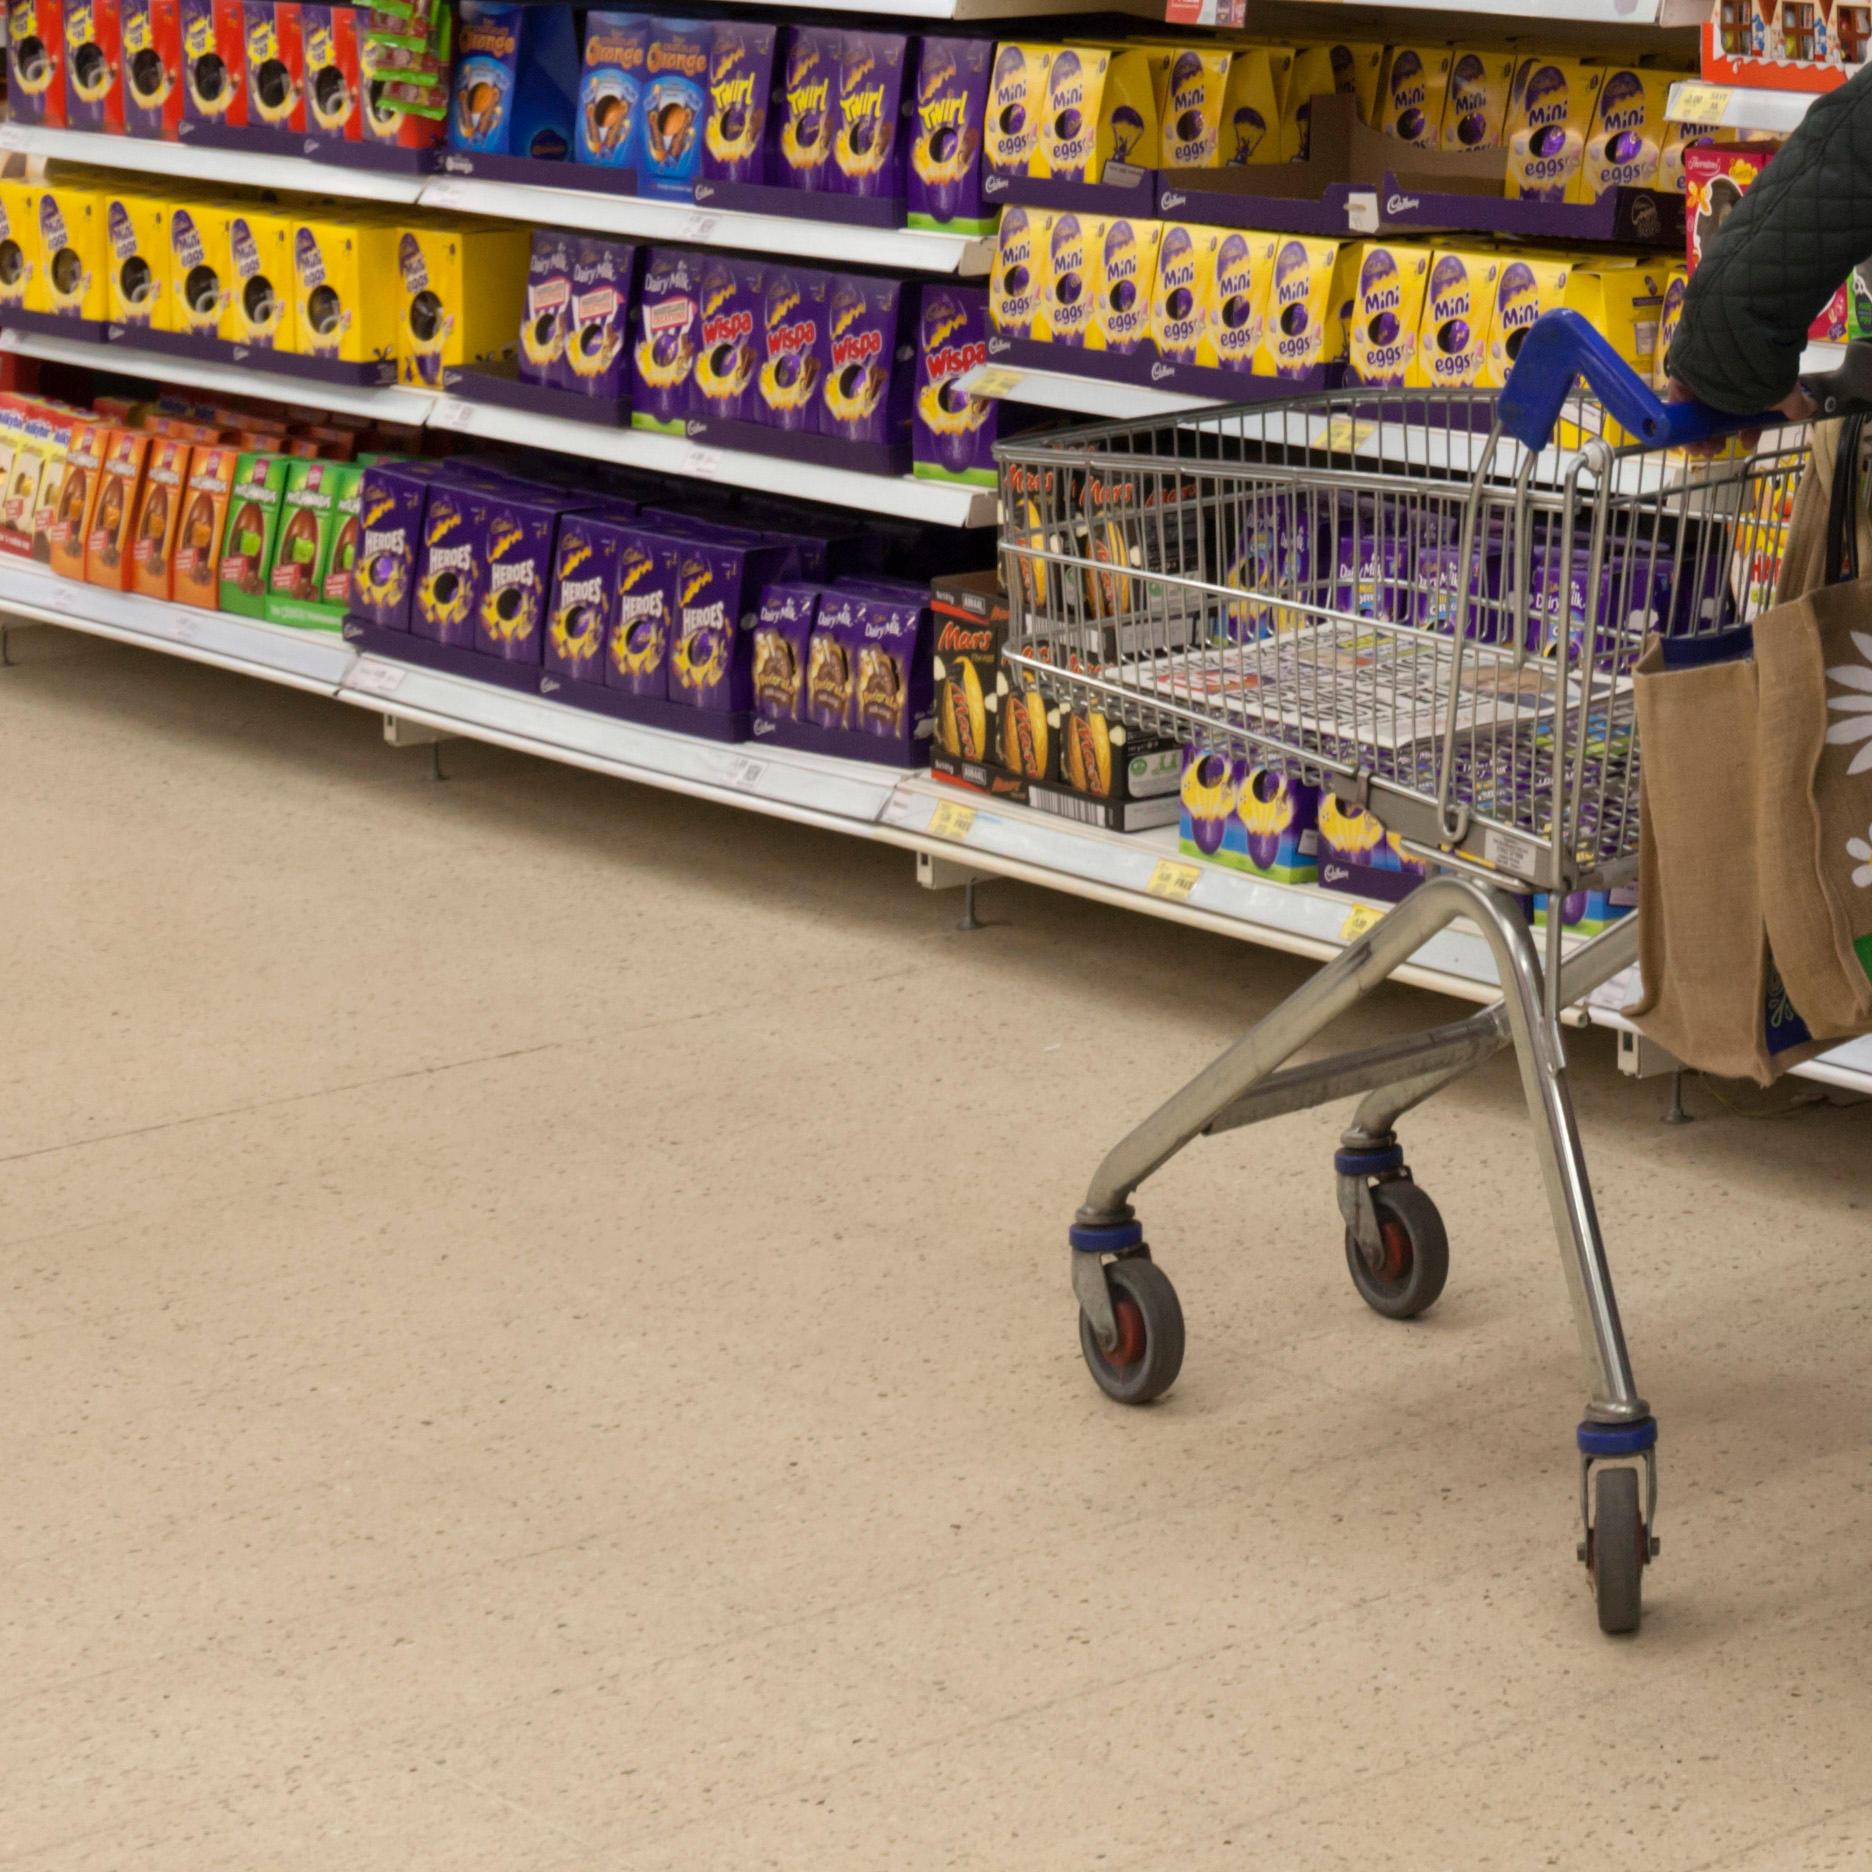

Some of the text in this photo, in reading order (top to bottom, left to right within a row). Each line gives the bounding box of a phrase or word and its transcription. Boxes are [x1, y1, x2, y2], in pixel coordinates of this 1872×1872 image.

[1526, 100, 1571, 128] Mini
[1524, 155, 1572, 178] eggs
[832, 330, 881, 359] Wispa
[490, 558, 536, 592] HEROES
